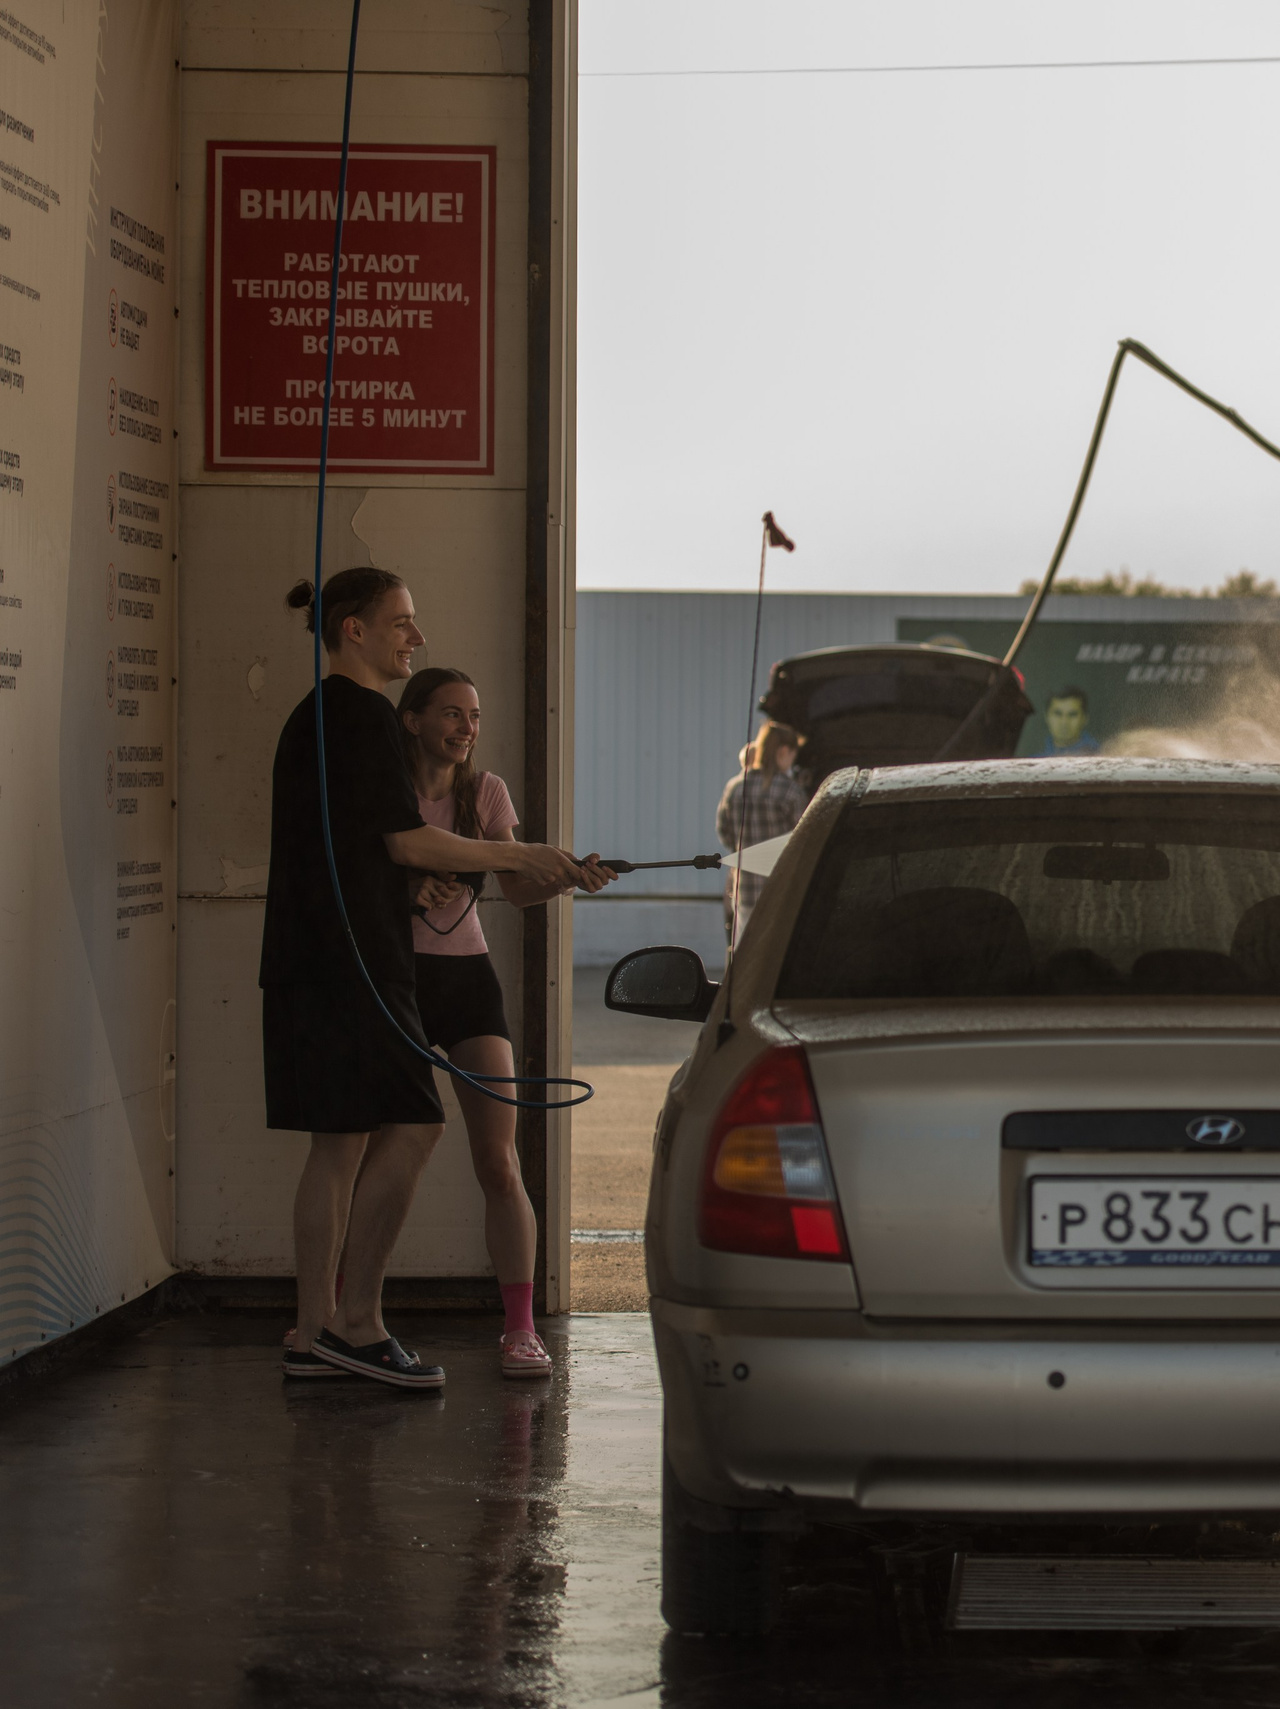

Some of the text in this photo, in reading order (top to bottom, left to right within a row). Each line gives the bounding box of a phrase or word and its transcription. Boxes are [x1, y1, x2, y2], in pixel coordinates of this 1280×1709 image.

[239, 188, 464, 223] ВНИМАНИЕ!
[284, 253, 420, 274] РАБОТАЮТ
[232, 279, 470, 306] ТЕПЛОВЫЕ ПУШКИ,
[269, 305, 434, 328] ЗАКРЫВАЙТЕ
[302, 336, 401, 355] ВОРОТА
[285, 380, 415, 400] ПРОТИРКА
[233, 406, 467, 428] НЕ БОЛЕЕ 5 МИНУТ
[1076, 644, 1144, 662] НАБОР
[1149, 644, 1166, 662] В
